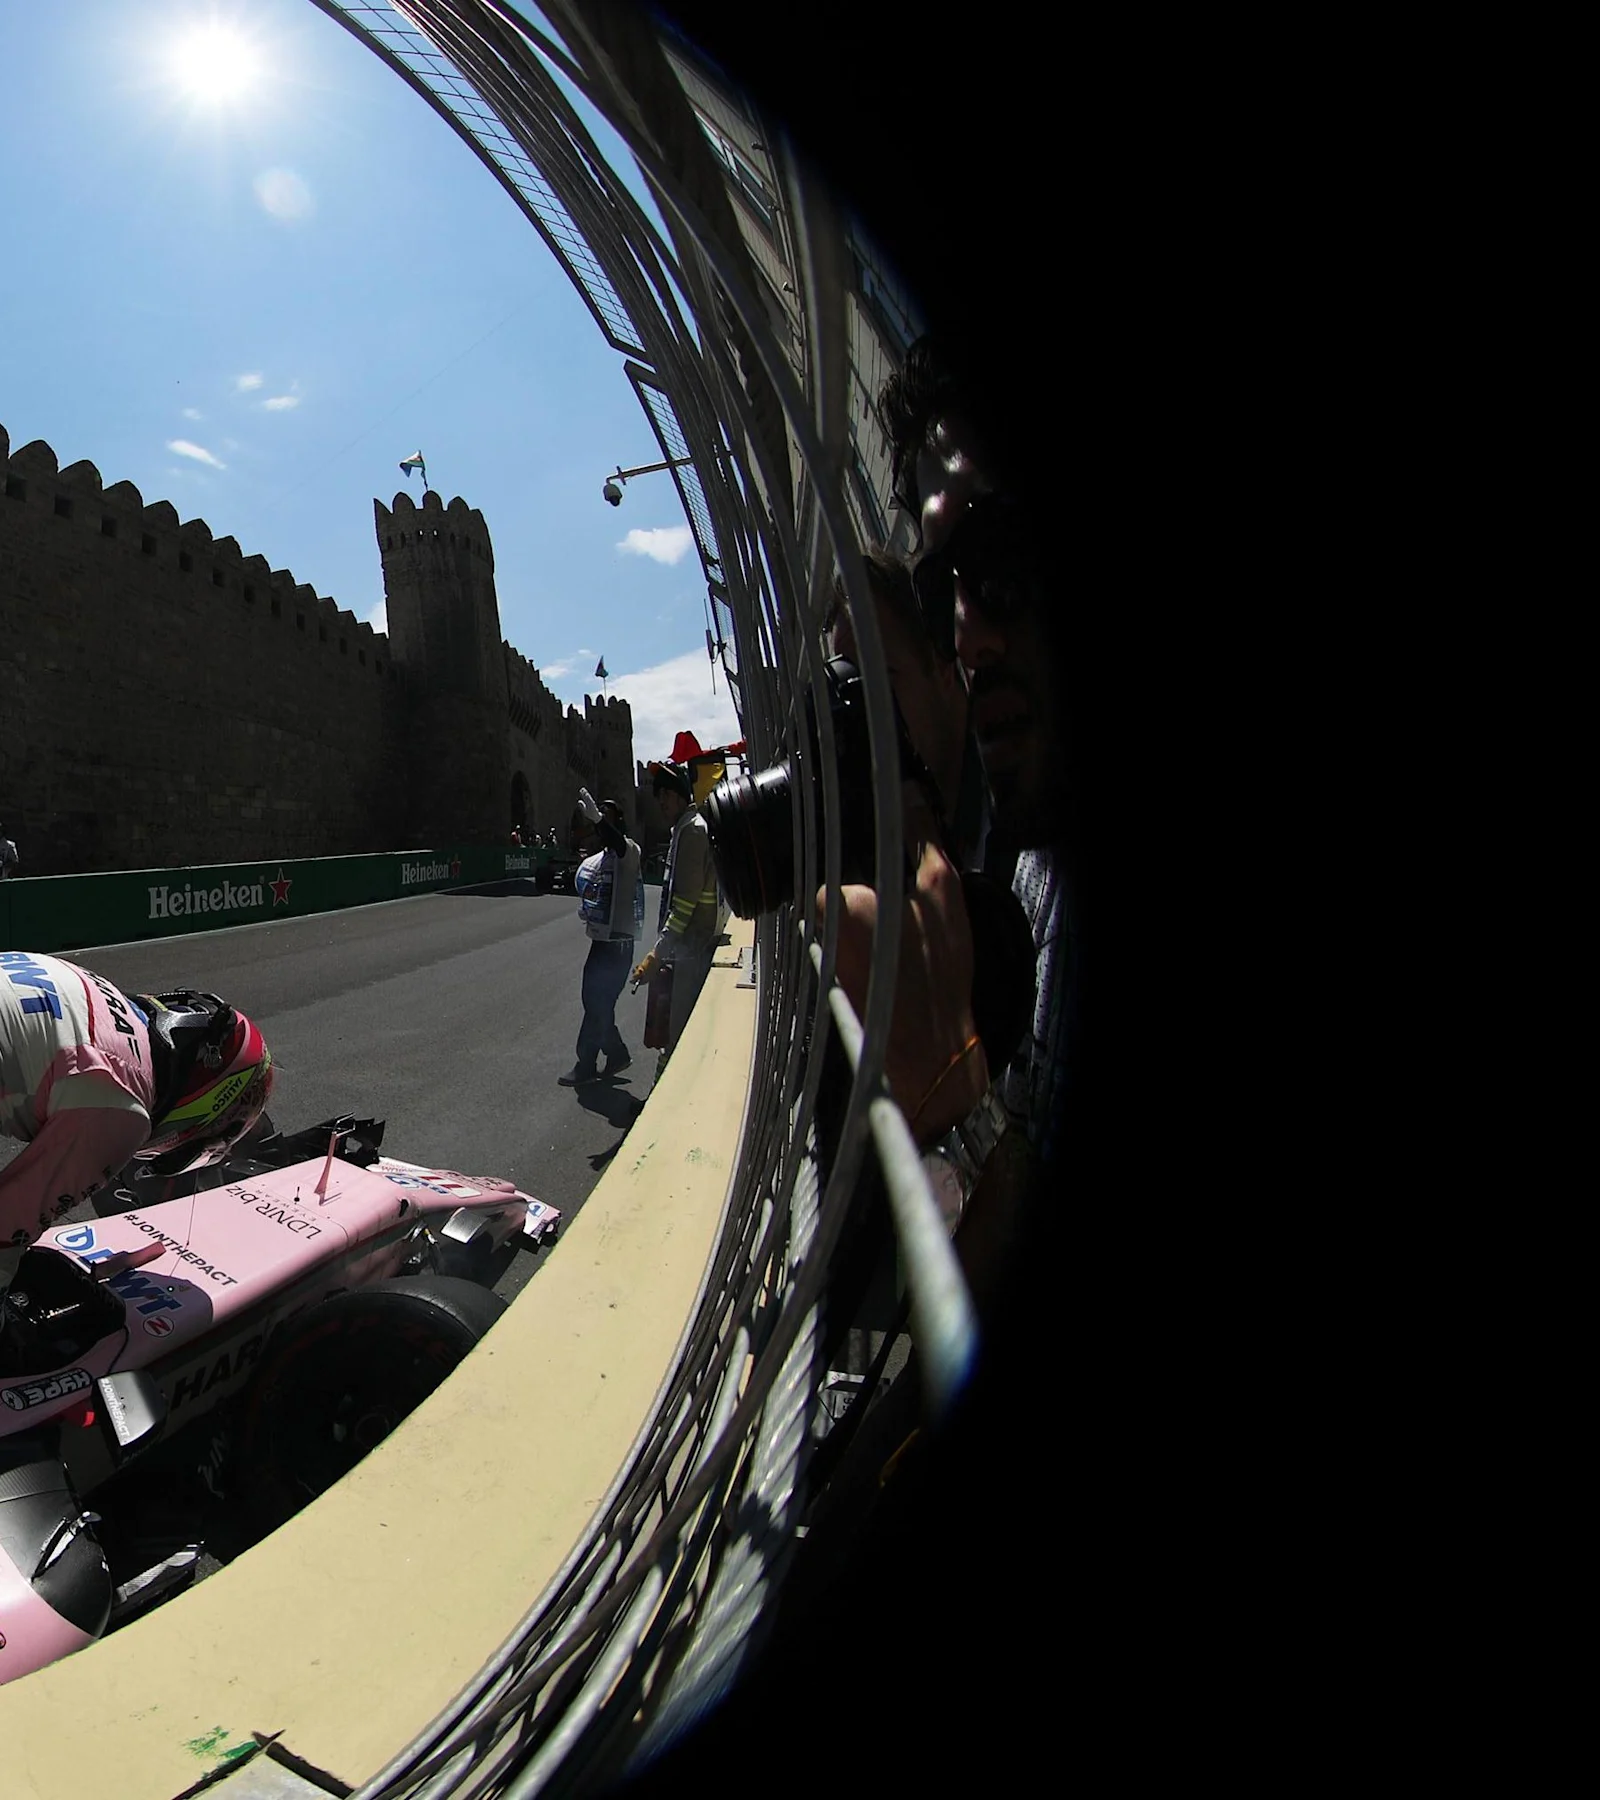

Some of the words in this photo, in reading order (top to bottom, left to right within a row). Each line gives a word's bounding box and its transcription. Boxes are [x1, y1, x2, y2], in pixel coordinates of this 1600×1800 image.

[401, 861, 449, 885] Heineken
[505, 853, 530, 870] Heineken
[148, 880, 264, 918] Heineken
[212, 1077, 242, 1112] JALISCO
[123, 1213, 239, 1287] #JOINTHEPACT
[24, 1371, 91, 1405] HYPE
[100, 1379, 131, 1437] #JOINTHEPACT
